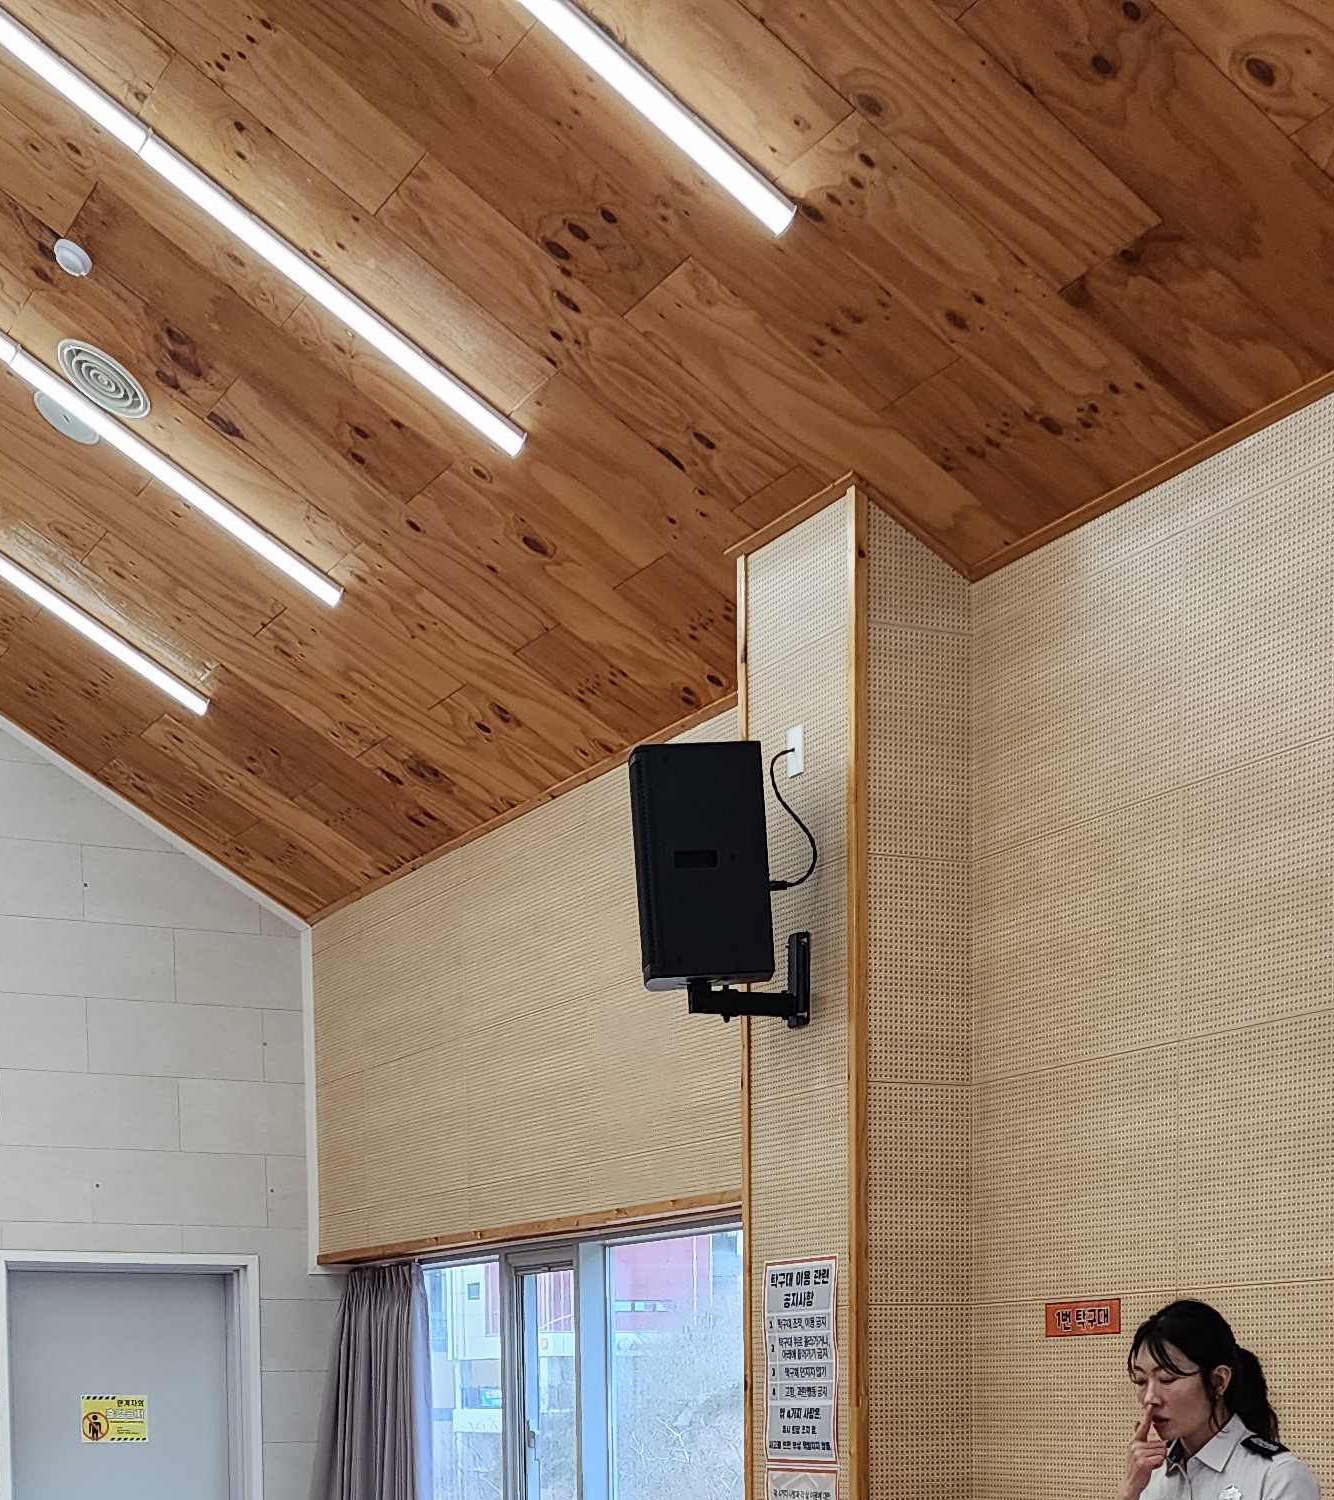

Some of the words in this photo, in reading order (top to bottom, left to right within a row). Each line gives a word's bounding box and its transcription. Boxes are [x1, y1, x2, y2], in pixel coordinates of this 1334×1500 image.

[770, 1272, 794, 1289] 탁구대
[795, 1270, 811, 1287] 이용
[813, 1268, 830, 1286] 관련
[783, 1290, 815, 1309] 공지사항
[1075, 1308, 1109, 1330] 탁구대
